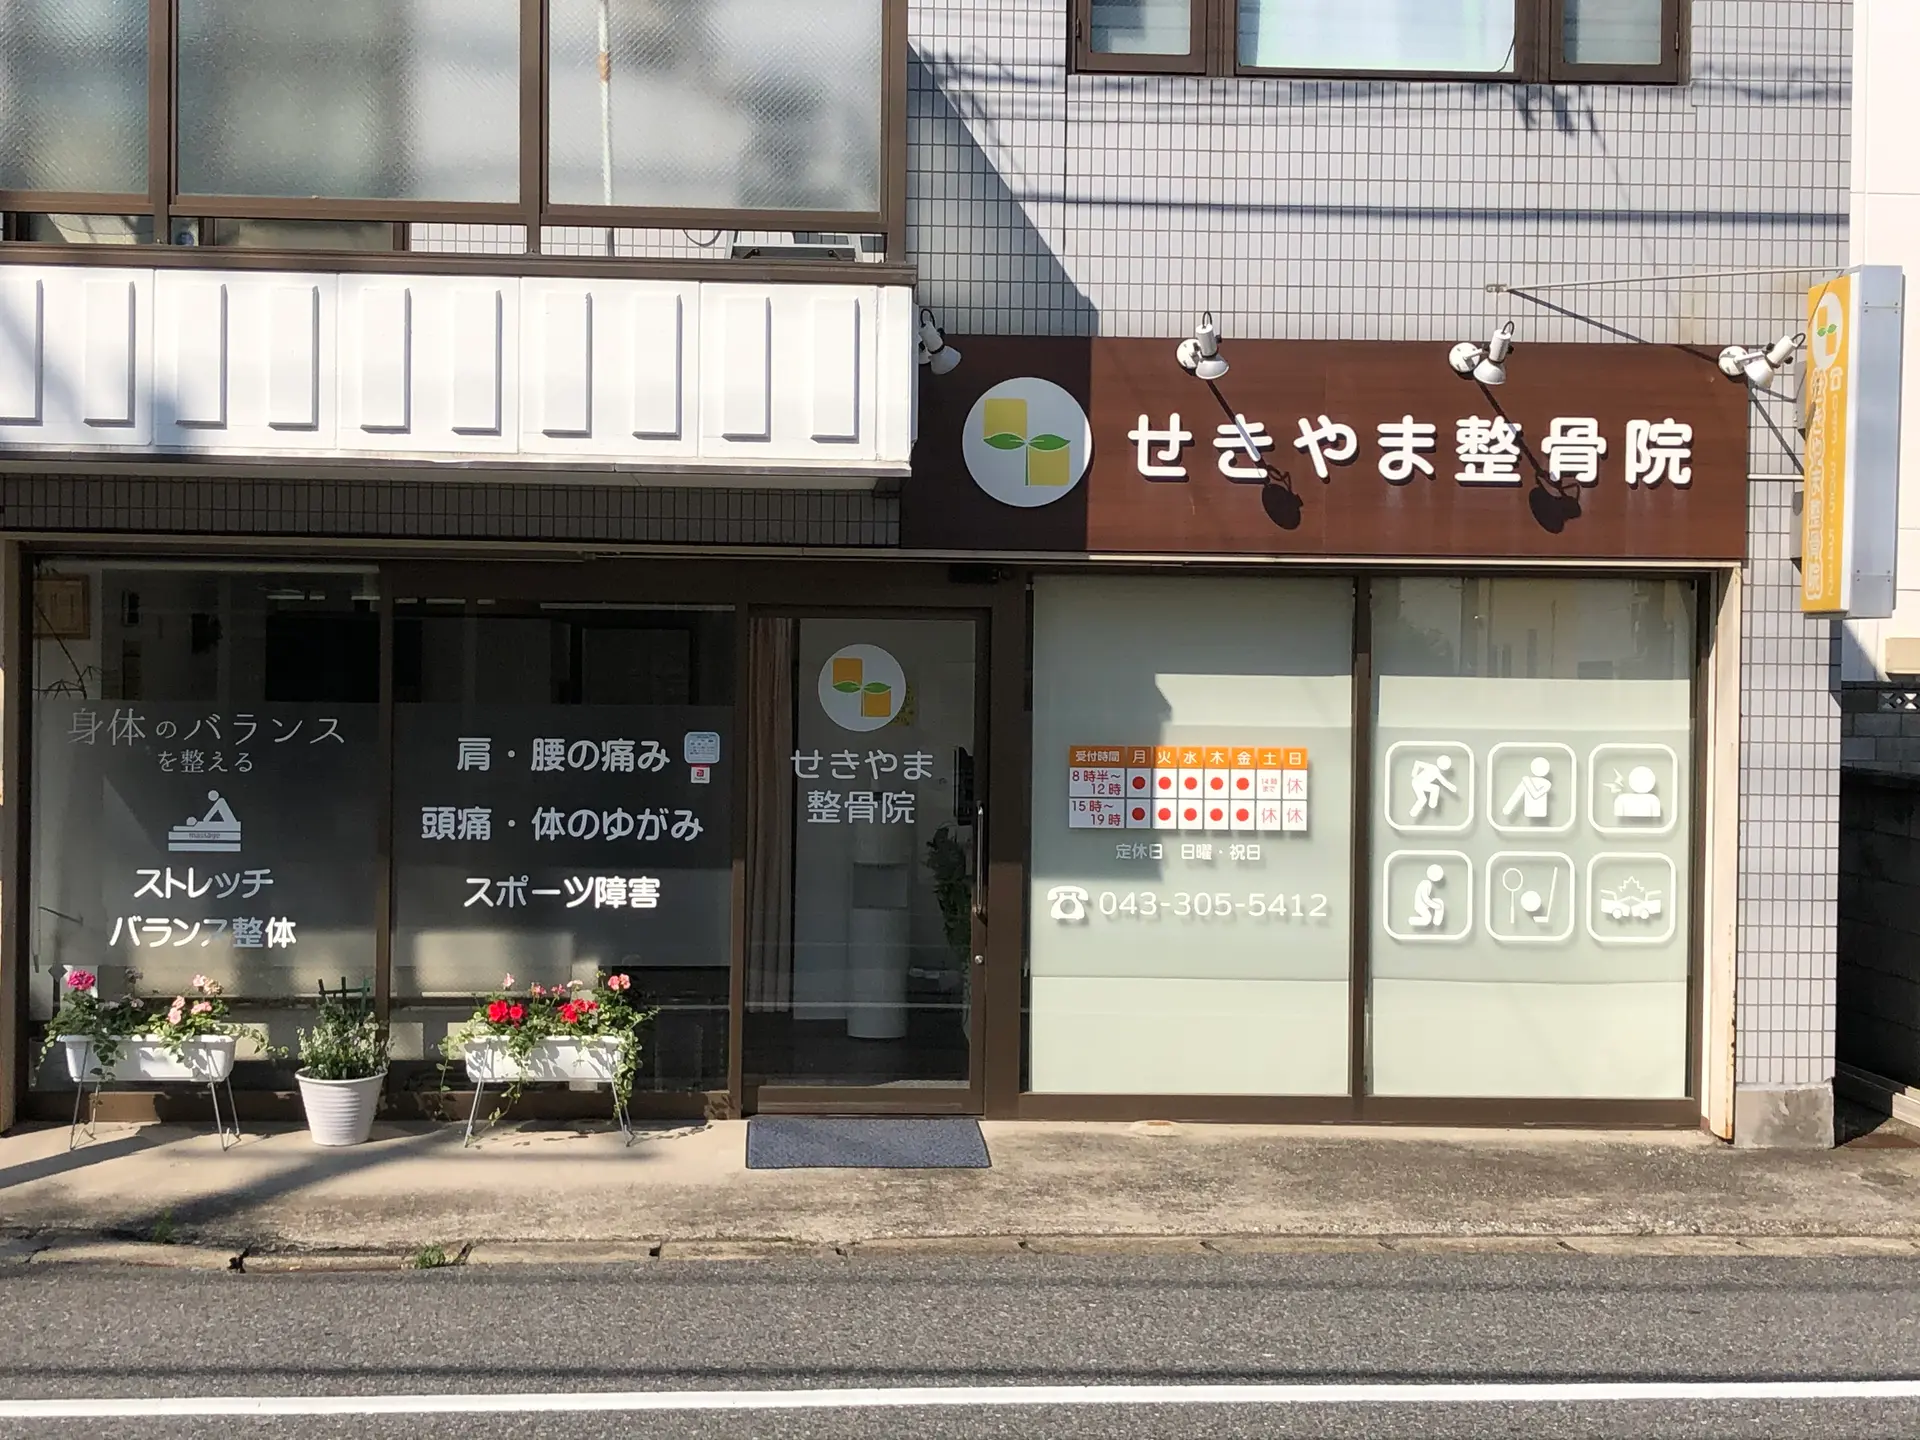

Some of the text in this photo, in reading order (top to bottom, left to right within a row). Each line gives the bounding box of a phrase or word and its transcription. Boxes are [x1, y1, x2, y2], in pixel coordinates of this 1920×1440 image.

[1127, 412, 1694, 485] せきやま整骨院
[67, 707, 346, 746] 身体のバランス
[157, 750, 254, 773] を整える
[457, 737, 671, 772] 肩・腰の痛み
[790, 749, 934, 780] せきやま
[1075, 750, 1301, 765] 受付時間 月 火 水 木 金 土 日
[1287, 777, 1304, 795] 休
[807, 790, 915, 824] 整骨院
[1261, 807, 1304, 824] 休 休
[421, 806, 704, 841] 頭痛・体のゆがみ
[1115, 843, 1261, 861] 定休日 日曜・祝日
[134, 867, 274, 899] ストレッチ
[464, 875, 661, 909] スポーツ障害
[1098, 891, 1328, 918] 043-305-5412
[109, 916, 297, 949] バランス整体
